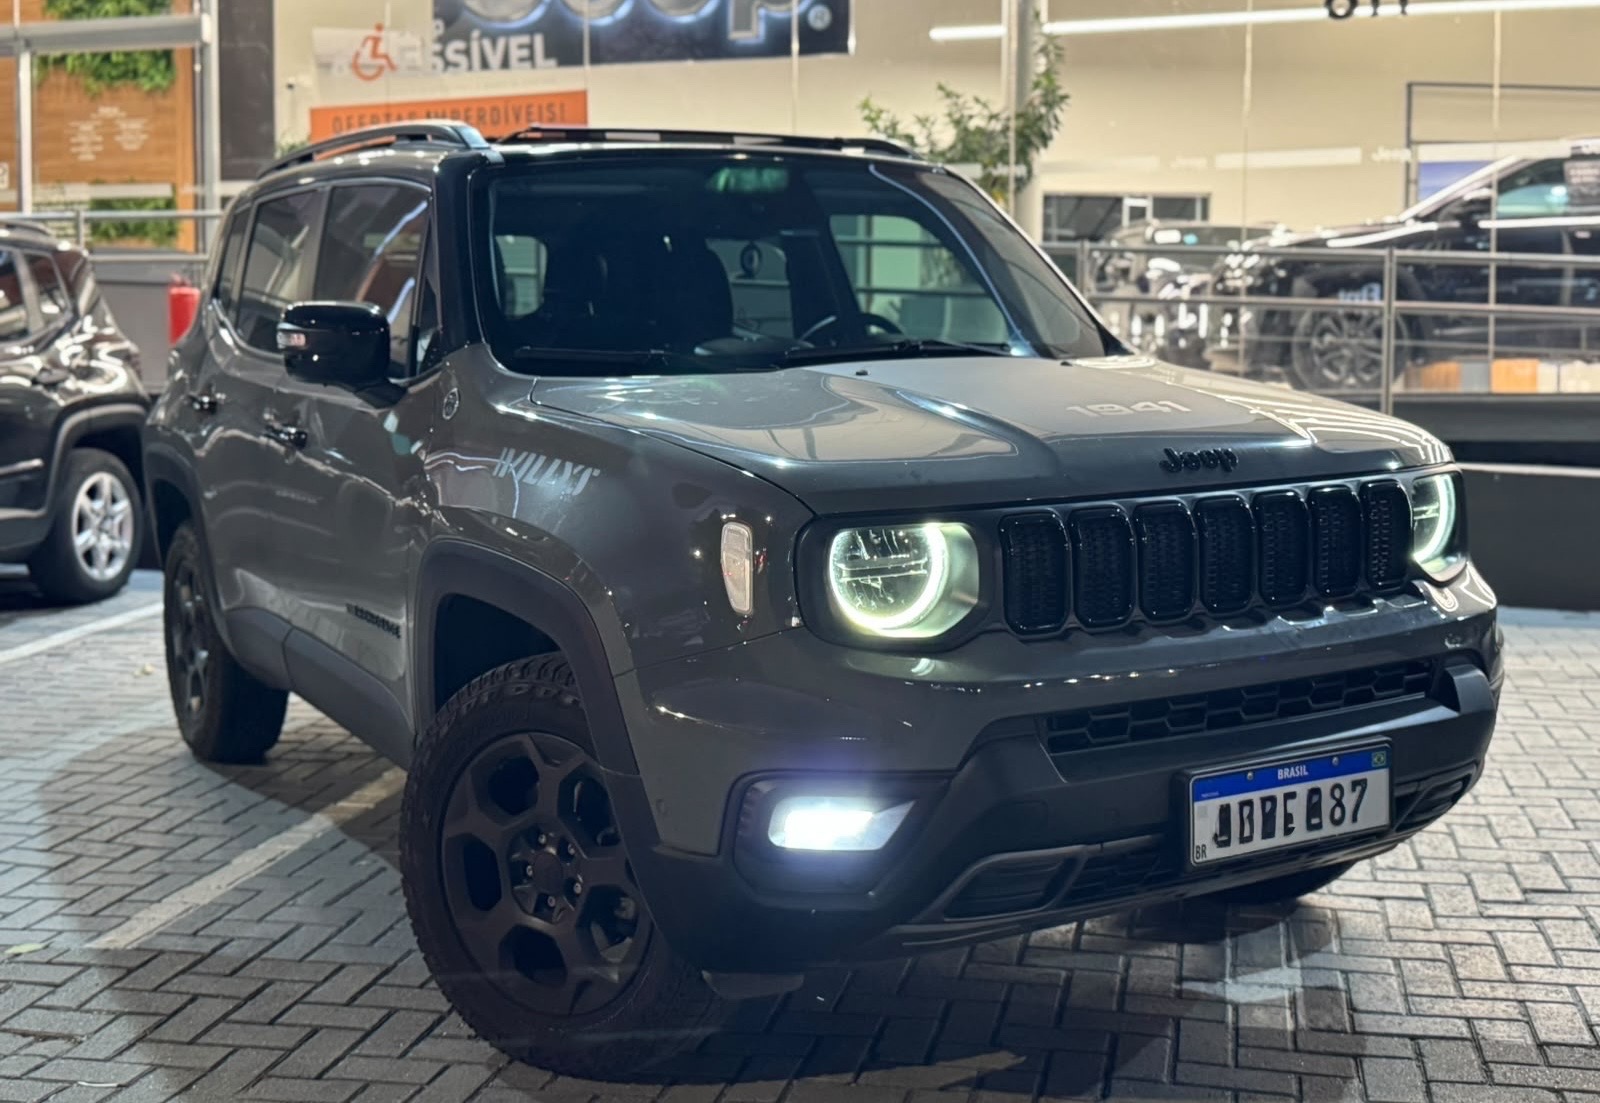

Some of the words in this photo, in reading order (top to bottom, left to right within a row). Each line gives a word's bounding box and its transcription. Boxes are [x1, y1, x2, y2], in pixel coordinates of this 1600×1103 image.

[1066, 400, 1191, 417] 1941
[1159, 447, 1239, 473] Jeep
[1277, 764, 1309, 780] BRASIL
[1195, 844, 1208, 860] BR
